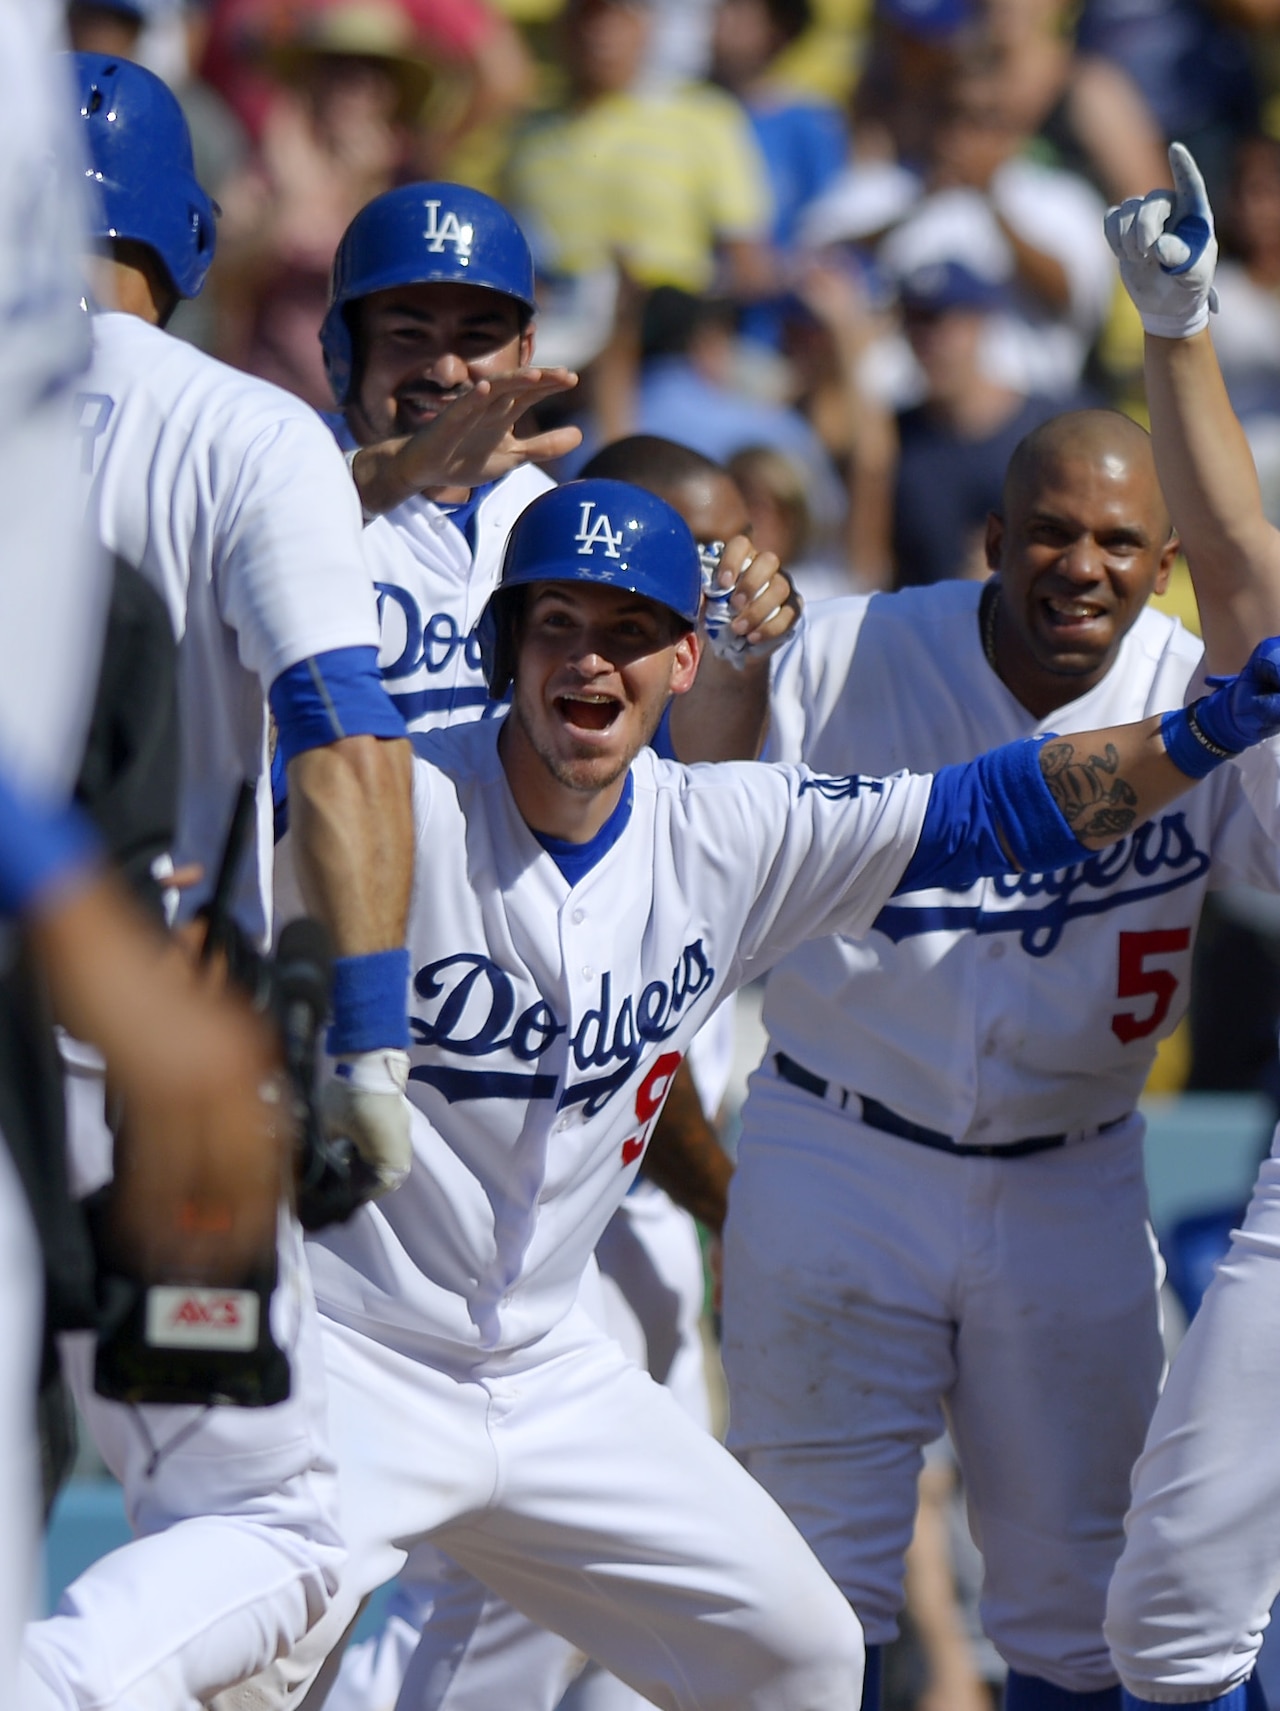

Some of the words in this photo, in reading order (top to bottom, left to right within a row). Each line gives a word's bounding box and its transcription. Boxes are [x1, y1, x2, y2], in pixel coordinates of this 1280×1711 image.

[423, 199, 474, 256] LA
[574, 502, 623, 559] LA
[410, 939, 715, 1118] Dodgers
[1111, 926, 1193, 1045] 5
[621, 1050, 682, 1168] 9
